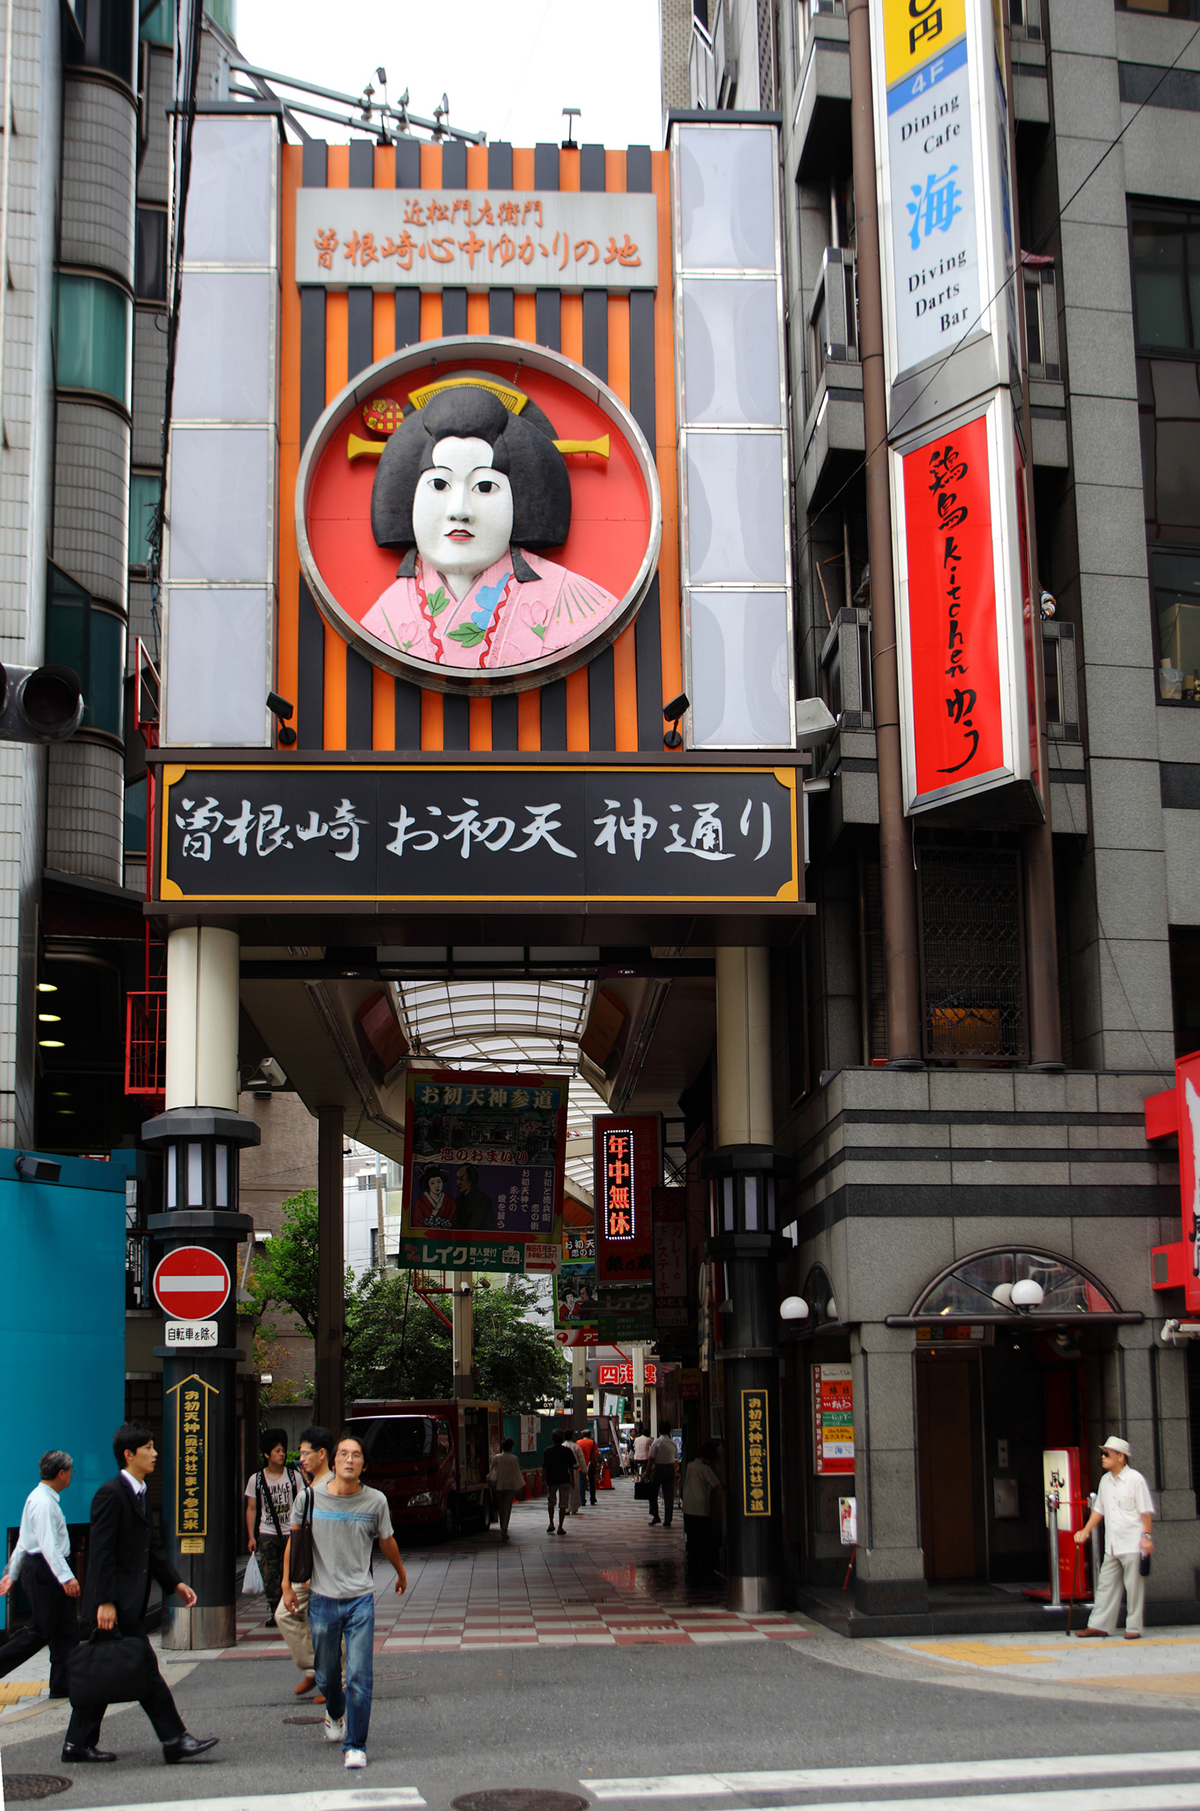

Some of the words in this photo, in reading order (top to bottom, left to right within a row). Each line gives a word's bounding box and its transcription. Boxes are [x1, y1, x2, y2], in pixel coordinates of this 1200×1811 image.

[911, 58, 945, 95] 4F
[901, 94, 960, 142] Dining
[923, 122, 961, 154] Cafe
[403, 199, 543, 228] 近松門左衛門
[906, 164, 962, 251] 海
[314, 228, 642, 271] 曽根崎心中ゆかりの地
[908, 249, 967, 294] Diving
[915, 283, 960, 318] Darts
[940, 306, 969, 333] Bar
[421, 1085, 554, 1110] お初天神参道
[441, 1147, 528, 1165] 恋のおまいり
[608, 1135, 630, 1236] 年中無休
[422, 1244, 468, 1265] レイク
[469, 1257, 497, 1266] コーナー
[168, 1327, 216, 1341] 自転車を除く
